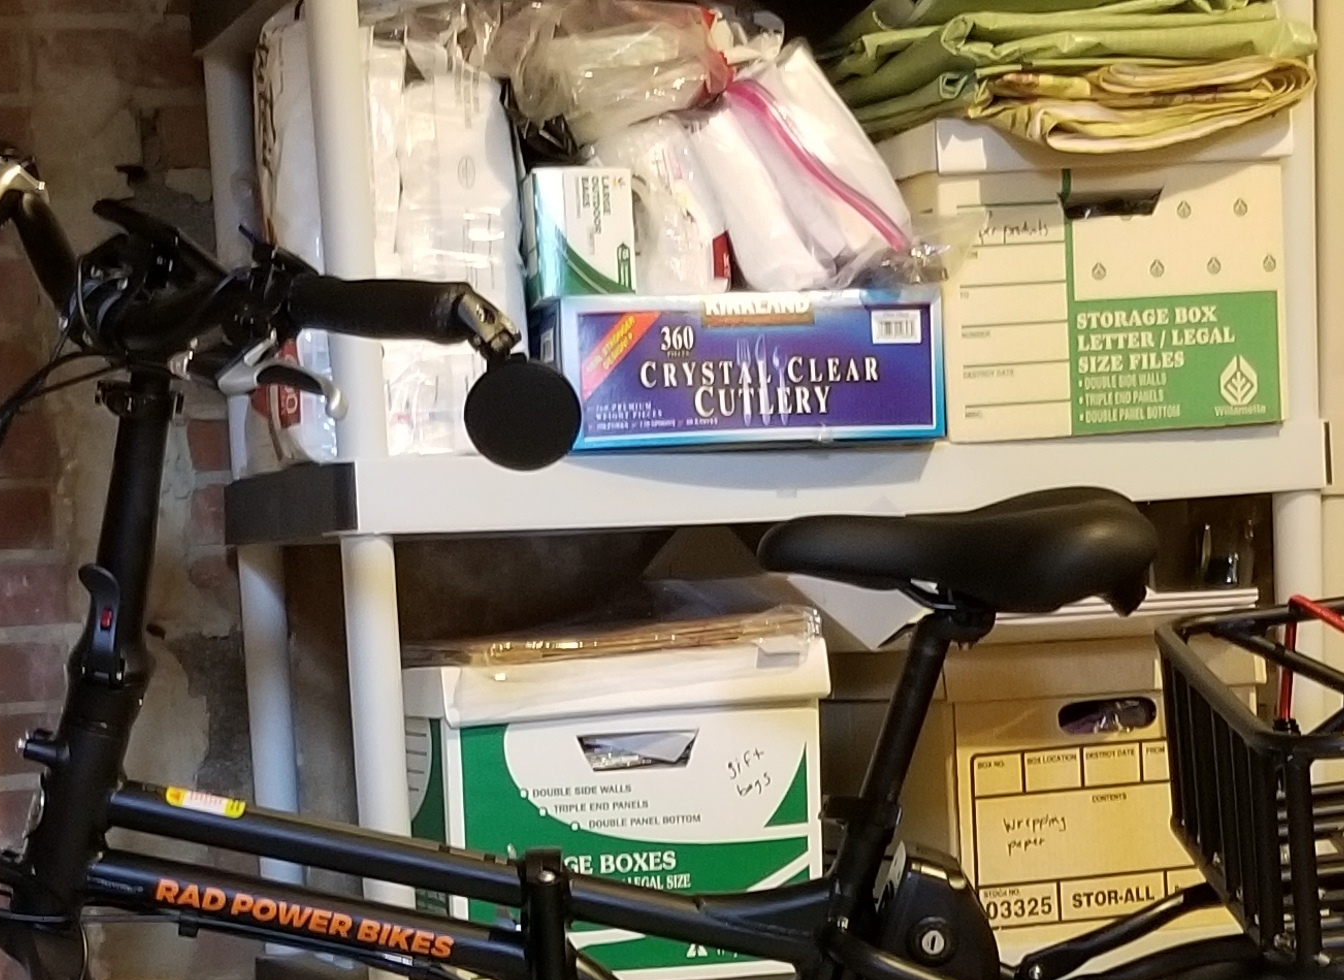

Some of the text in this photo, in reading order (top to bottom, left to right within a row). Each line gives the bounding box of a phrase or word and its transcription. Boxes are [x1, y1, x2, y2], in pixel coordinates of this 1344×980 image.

[581, 177, 590, 208] BAGS
[592, 175, 601, 234] OUTDOOR
[602, 175, 611, 215] LARGE
[1076, 305, 1218, 330] STORAGE BOX
[660, 325, 694, 350] 360
[1077, 327, 1236, 351] LETTER / LEGAL
[640, 356, 879, 388] CRYSTAL CLEAR
[1078, 351, 1185, 374] SIZE FILES
[1084, 372, 1167, 390] DOUBLE SIDE WALLS
[694, 385, 831, 417] CUTLERY
[1085, 388, 1164, 407] TRIPLE END PANELS
[1085, 404, 1181, 424] DOUBLE PANEL BOTTOM
[726, 748, 765, 779] gift
[1027, 753, 1077, 766] BOX LOCATION
[1117, 748, 1135, 757] DATE
[977, 761, 993, 770] BOX
[532, 784, 632, 799] DOUBLE SIDE WALLS
[736, 772, 771, 796] bags
[554, 800, 649, 814] TRIPLE END PANELS
[1092, 792, 1127, 803] CONTENTS
[588, 813, 701, 829] DOUBLE PANEL BOTTOM
[599, 850, 677, 874] BOXES
[666, 873, 691, 890] SIZE
[156, 878, 455, 959] RAD POWER BIKES
[985, 896, 1053, 920] 03325
